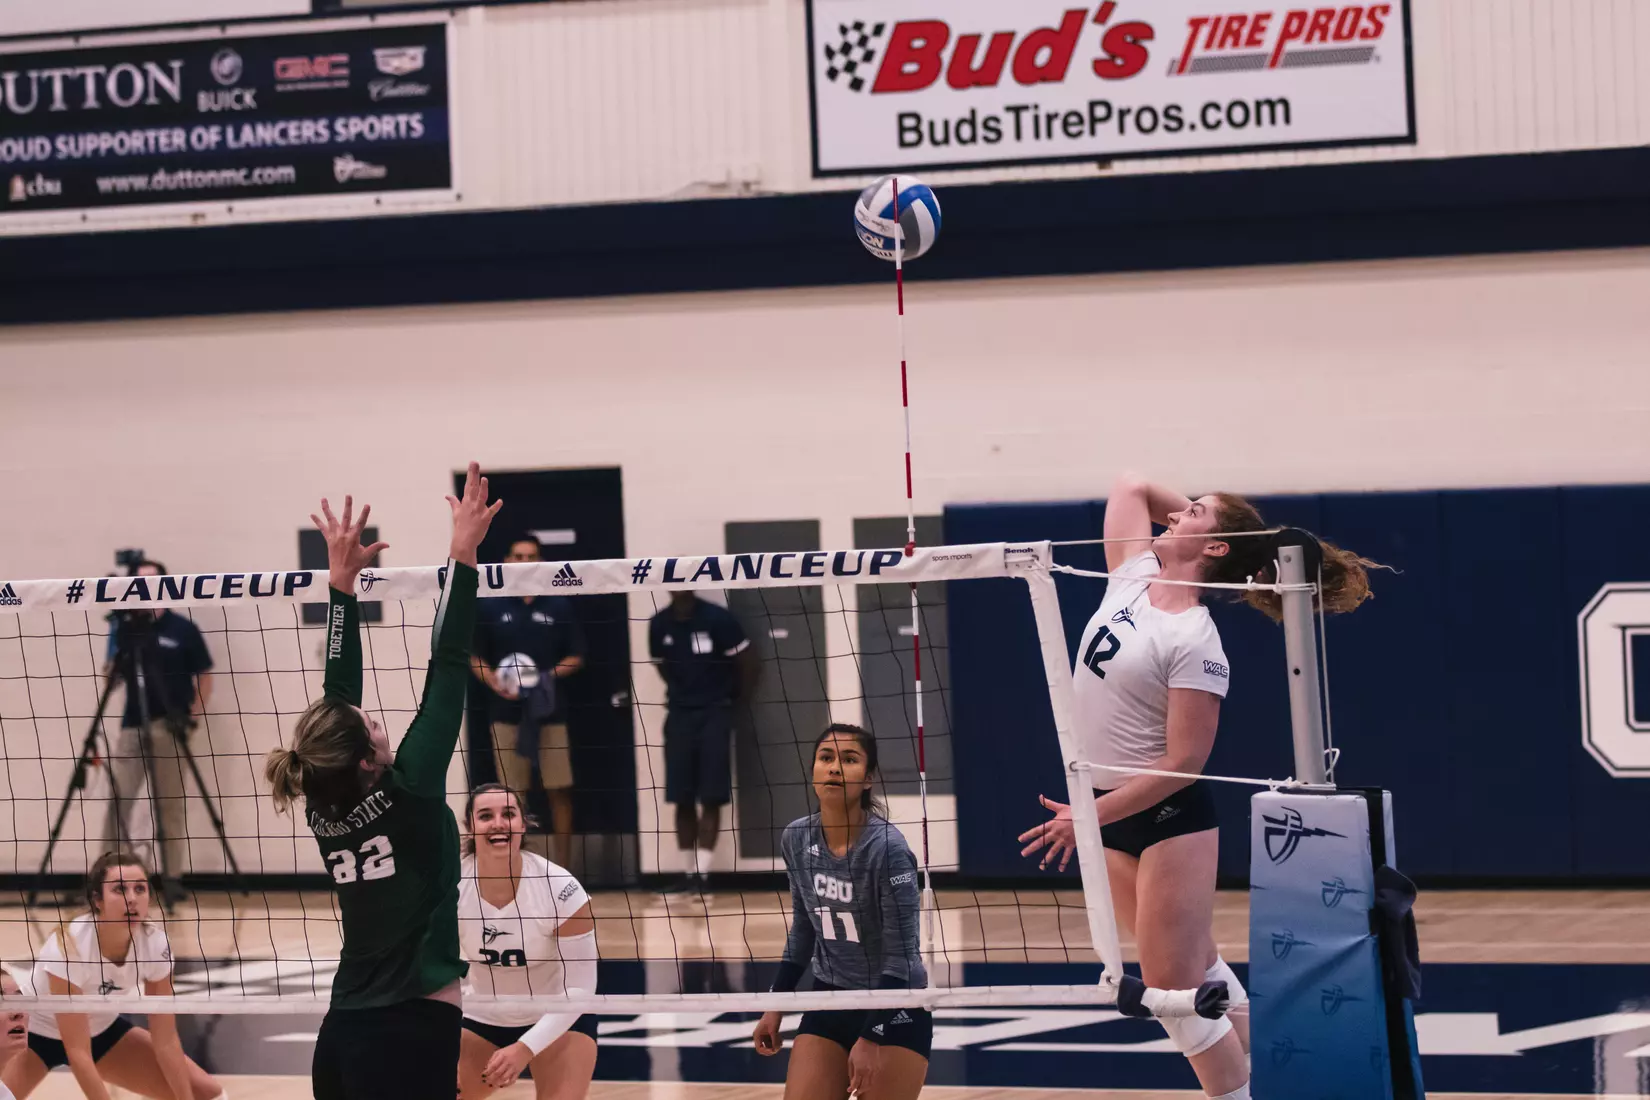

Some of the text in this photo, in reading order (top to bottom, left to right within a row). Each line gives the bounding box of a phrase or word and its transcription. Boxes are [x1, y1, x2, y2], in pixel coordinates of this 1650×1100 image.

[872, 0, 1154, 94] Bud's
[1175, 4, 1390, 73] TIRE PROS
[273, 53, 350, 81] GMC
[0, 61, 184, 114] UTTON
[197, 88, 257, 113] BUICK
[55, 130, 187, 158] SUPPORTER
[191, 128, 222, 149] OF
[226, 119, 330, 149] LANCERS
[334, 113, 424, 142] SPORTS
[897, 97, 1291, 147] BudsTirePros.com
[96, 165, 296, 192] www.duttonmc.com
[551, 578, 583, 587] adidas
[631, 550, 901, 584] #LANCEUP
[0, 597, 22, 606] didas
[66, 572, 313, 604] #LANCEUP
[328, 603, 345, 660] TOGETHER
[1083, 625, 1121, 679] 12
[1203, 659, 1229, 677] WAC
[346, 790, 393, 828] STATE
[327, 835, 396, 884] 22
[813, 873, 854, 903] CBU
[890, 873, 912, 886] WAC
[814, 907, 860, 943] 11
